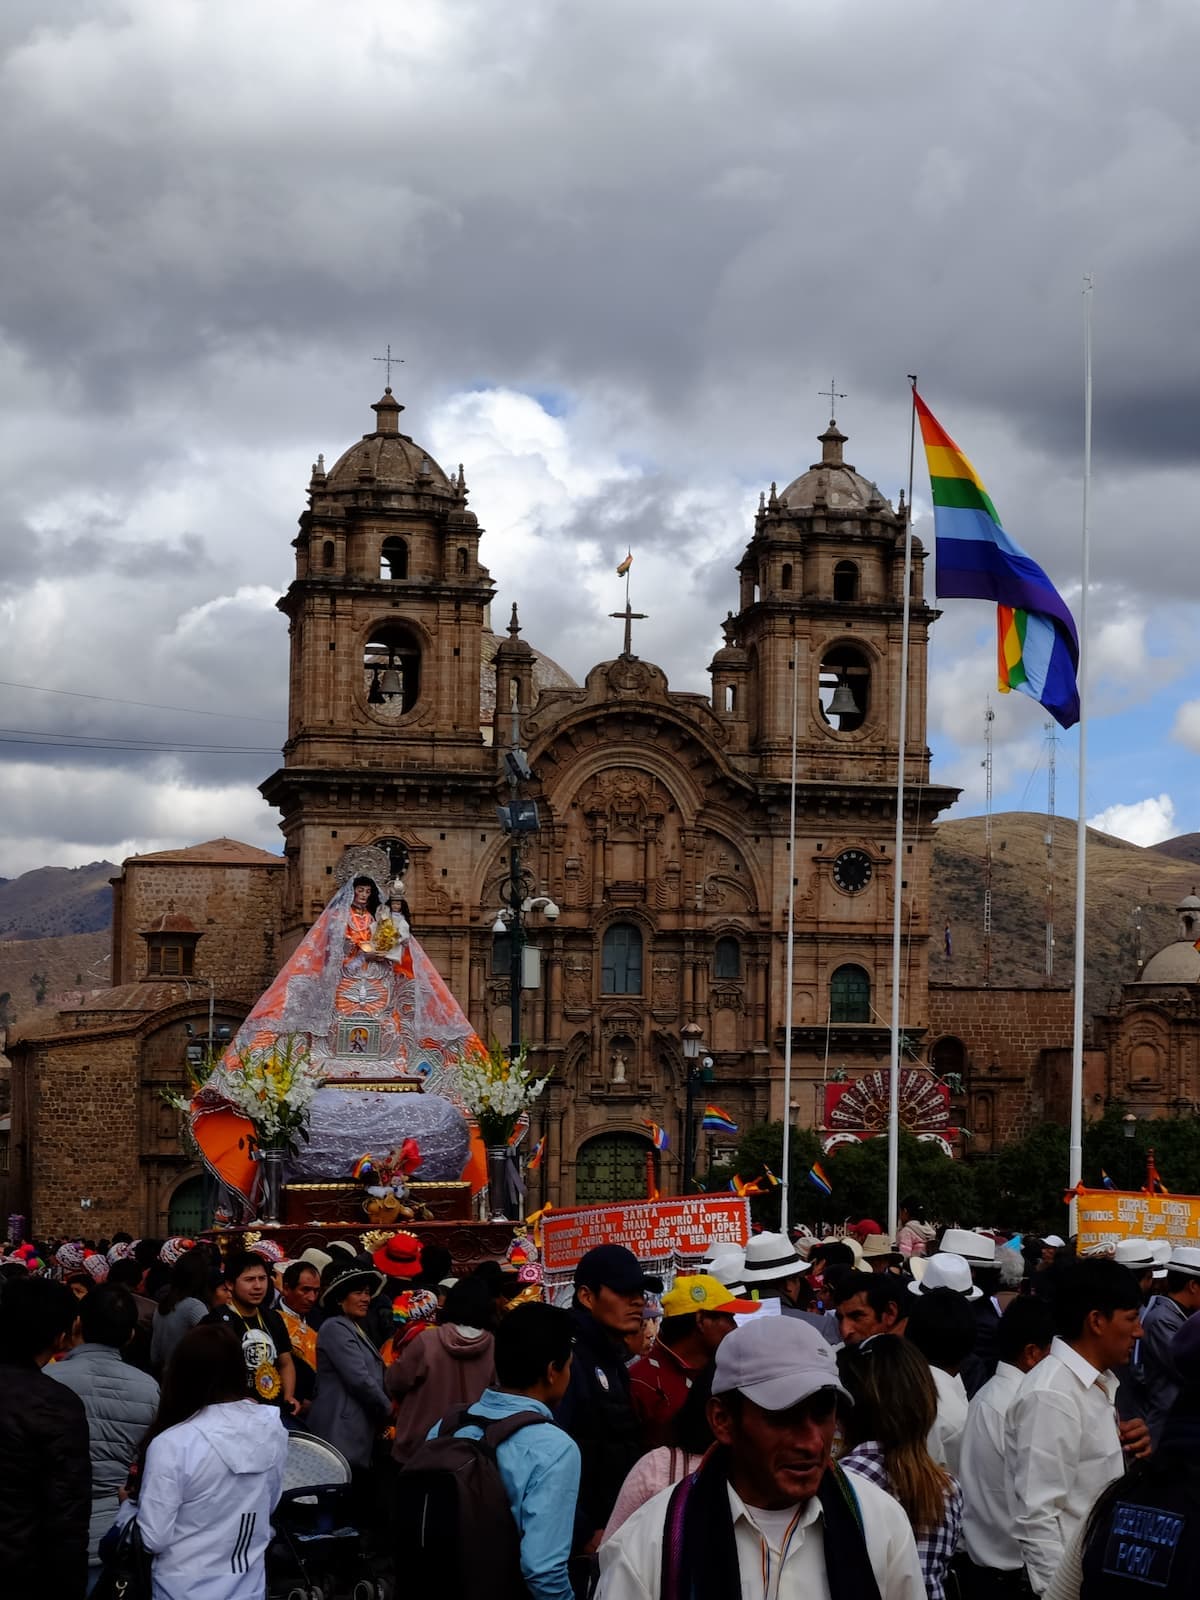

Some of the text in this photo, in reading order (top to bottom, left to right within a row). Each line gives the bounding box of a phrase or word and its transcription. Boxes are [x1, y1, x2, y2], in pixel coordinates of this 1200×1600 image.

[574, 1204, 706, 1226] ABUELA SANTA ANA
[590, 1222, 617, 1235] BRANY
[623, 1219, 652, 1231] SHAUL
[660, 1214, 693, 1227] ACURIO
[701, 1211, 729, 1223] LOPEZ
[734, 1211, 740, 1221] Y
[609, 1229, 647, 1243] CHALLCO
[654, 1227, 670, 1238] ESP
[675, 1224, 705, 1236] JUANA
[712, 1221, 741, 1233] LOPEZ
[638, 1237, 682, 1250] GONGORA
[690, 1231, 742, 1245] BENAVENTE
